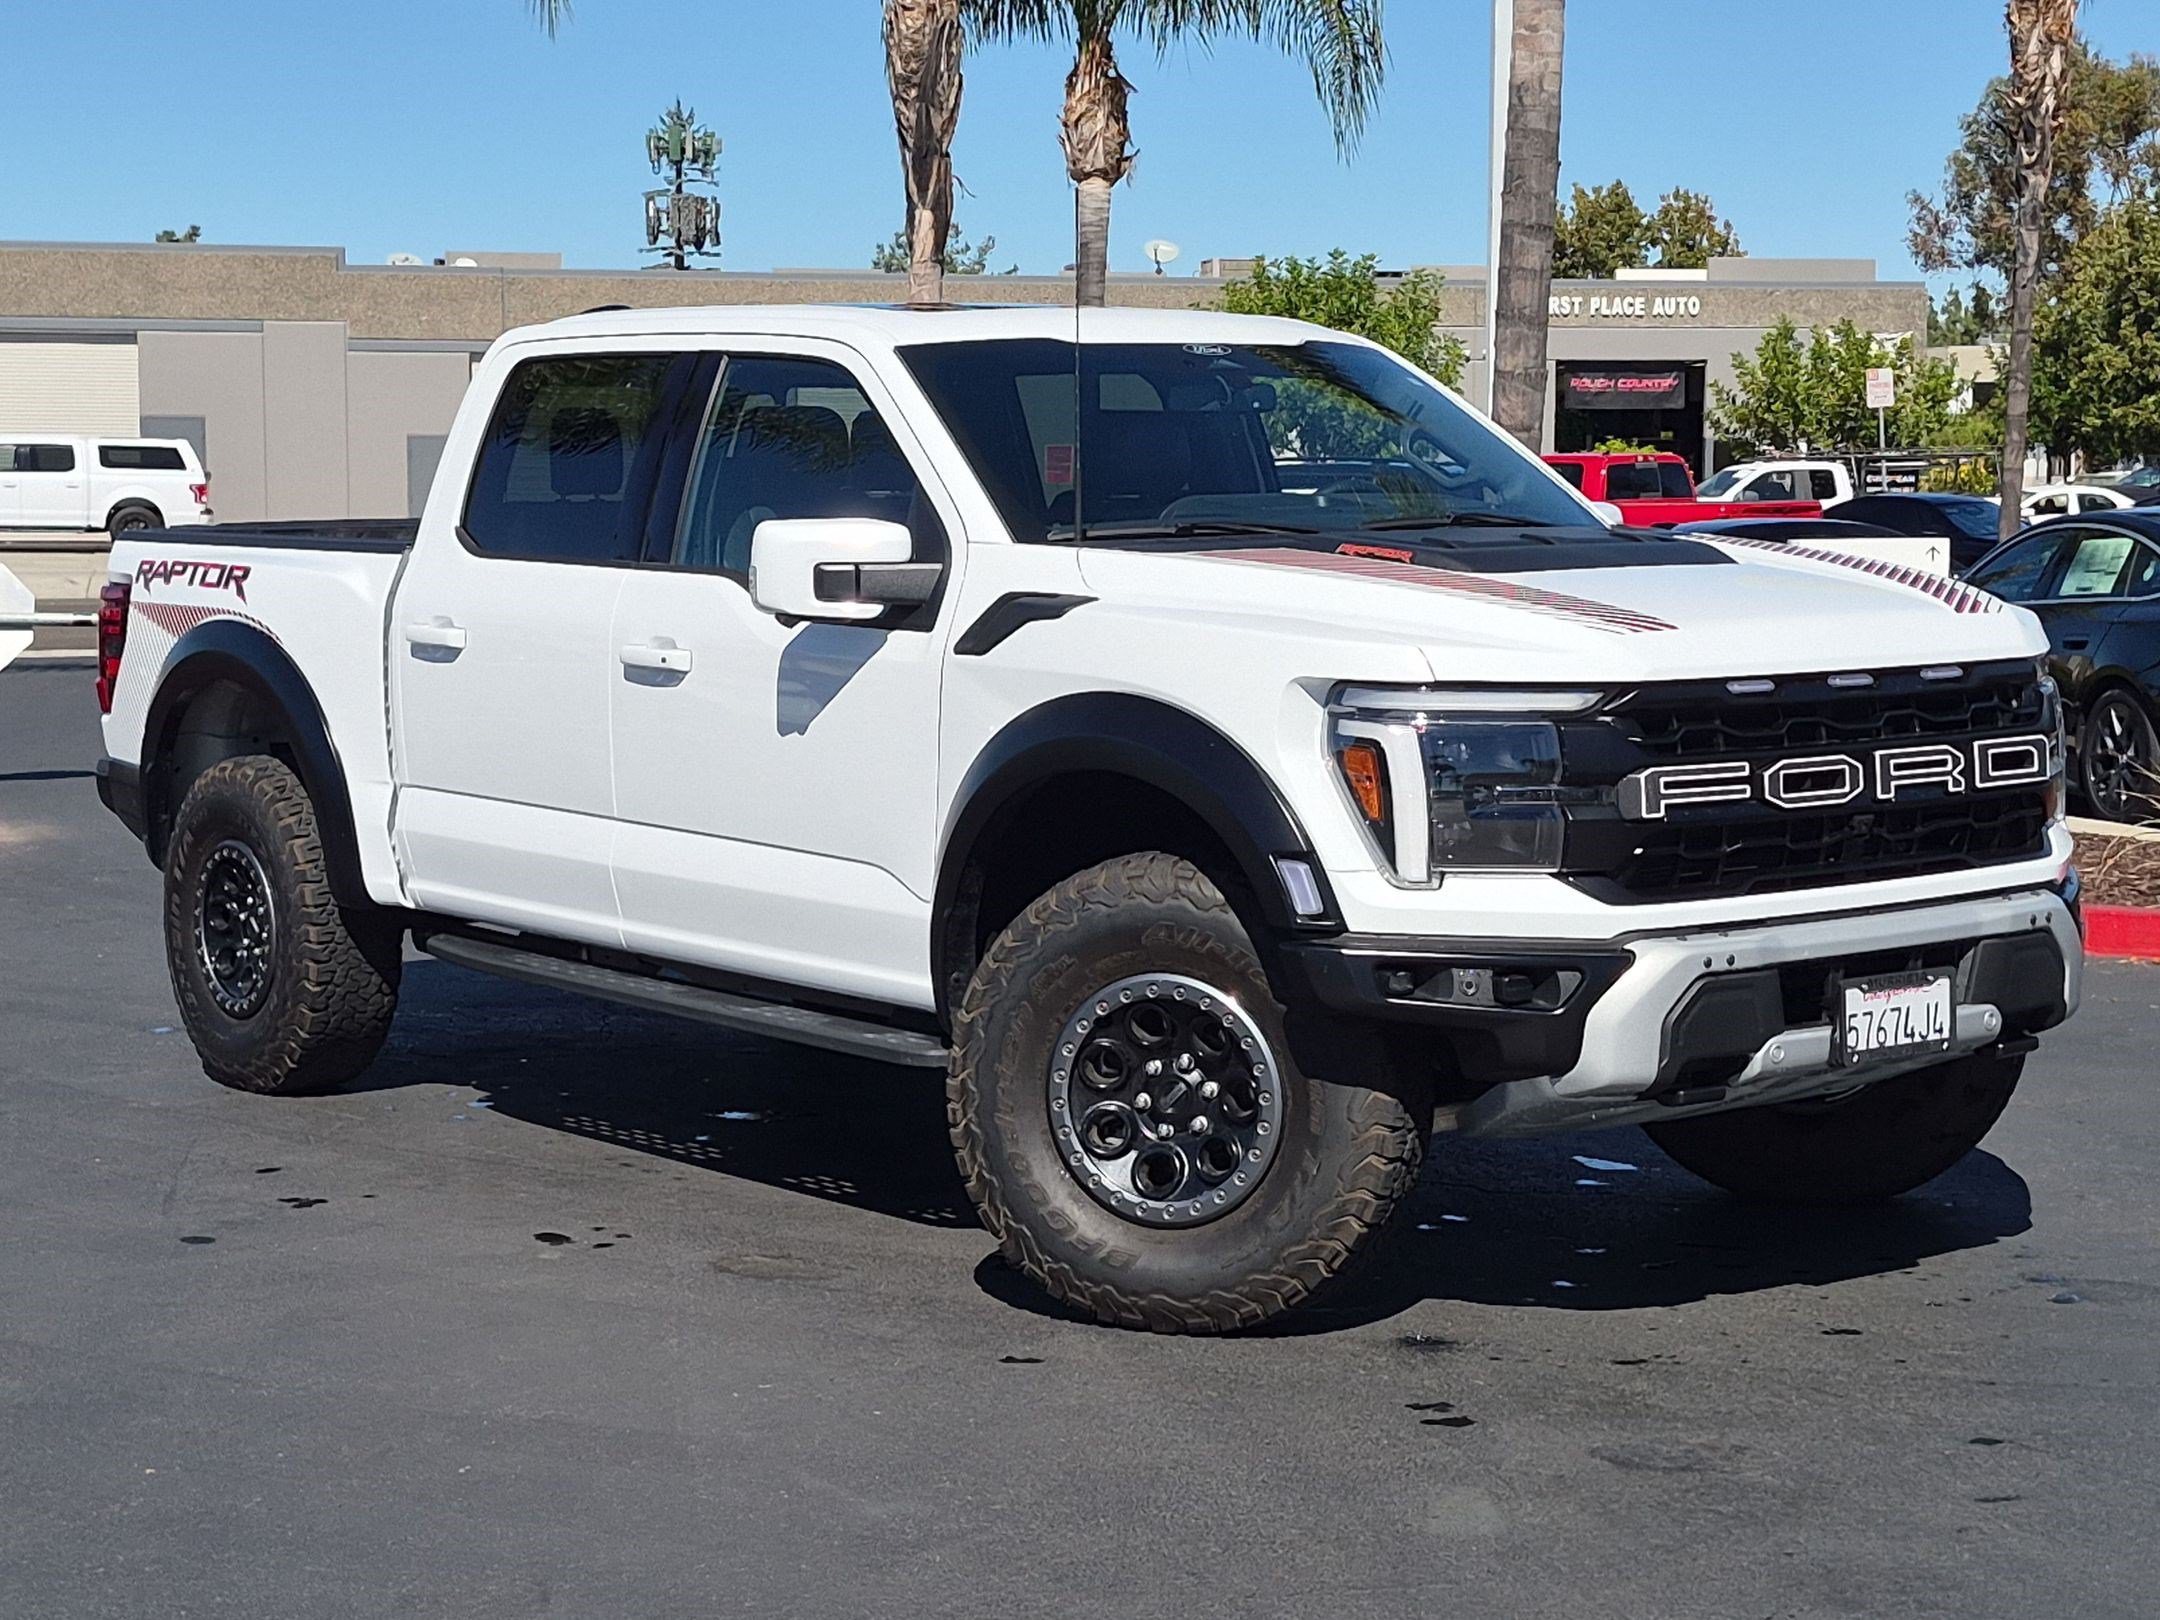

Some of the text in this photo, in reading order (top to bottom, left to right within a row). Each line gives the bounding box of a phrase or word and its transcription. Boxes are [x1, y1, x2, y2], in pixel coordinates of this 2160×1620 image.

[1549, 296, 1701, 316] RST PLACE AUTO
[135, 560, 251, 606] RAPTOR
[1639, 734, 2050, 819] FORD
[1847, 1001, 1944, 1050] 57674J4
